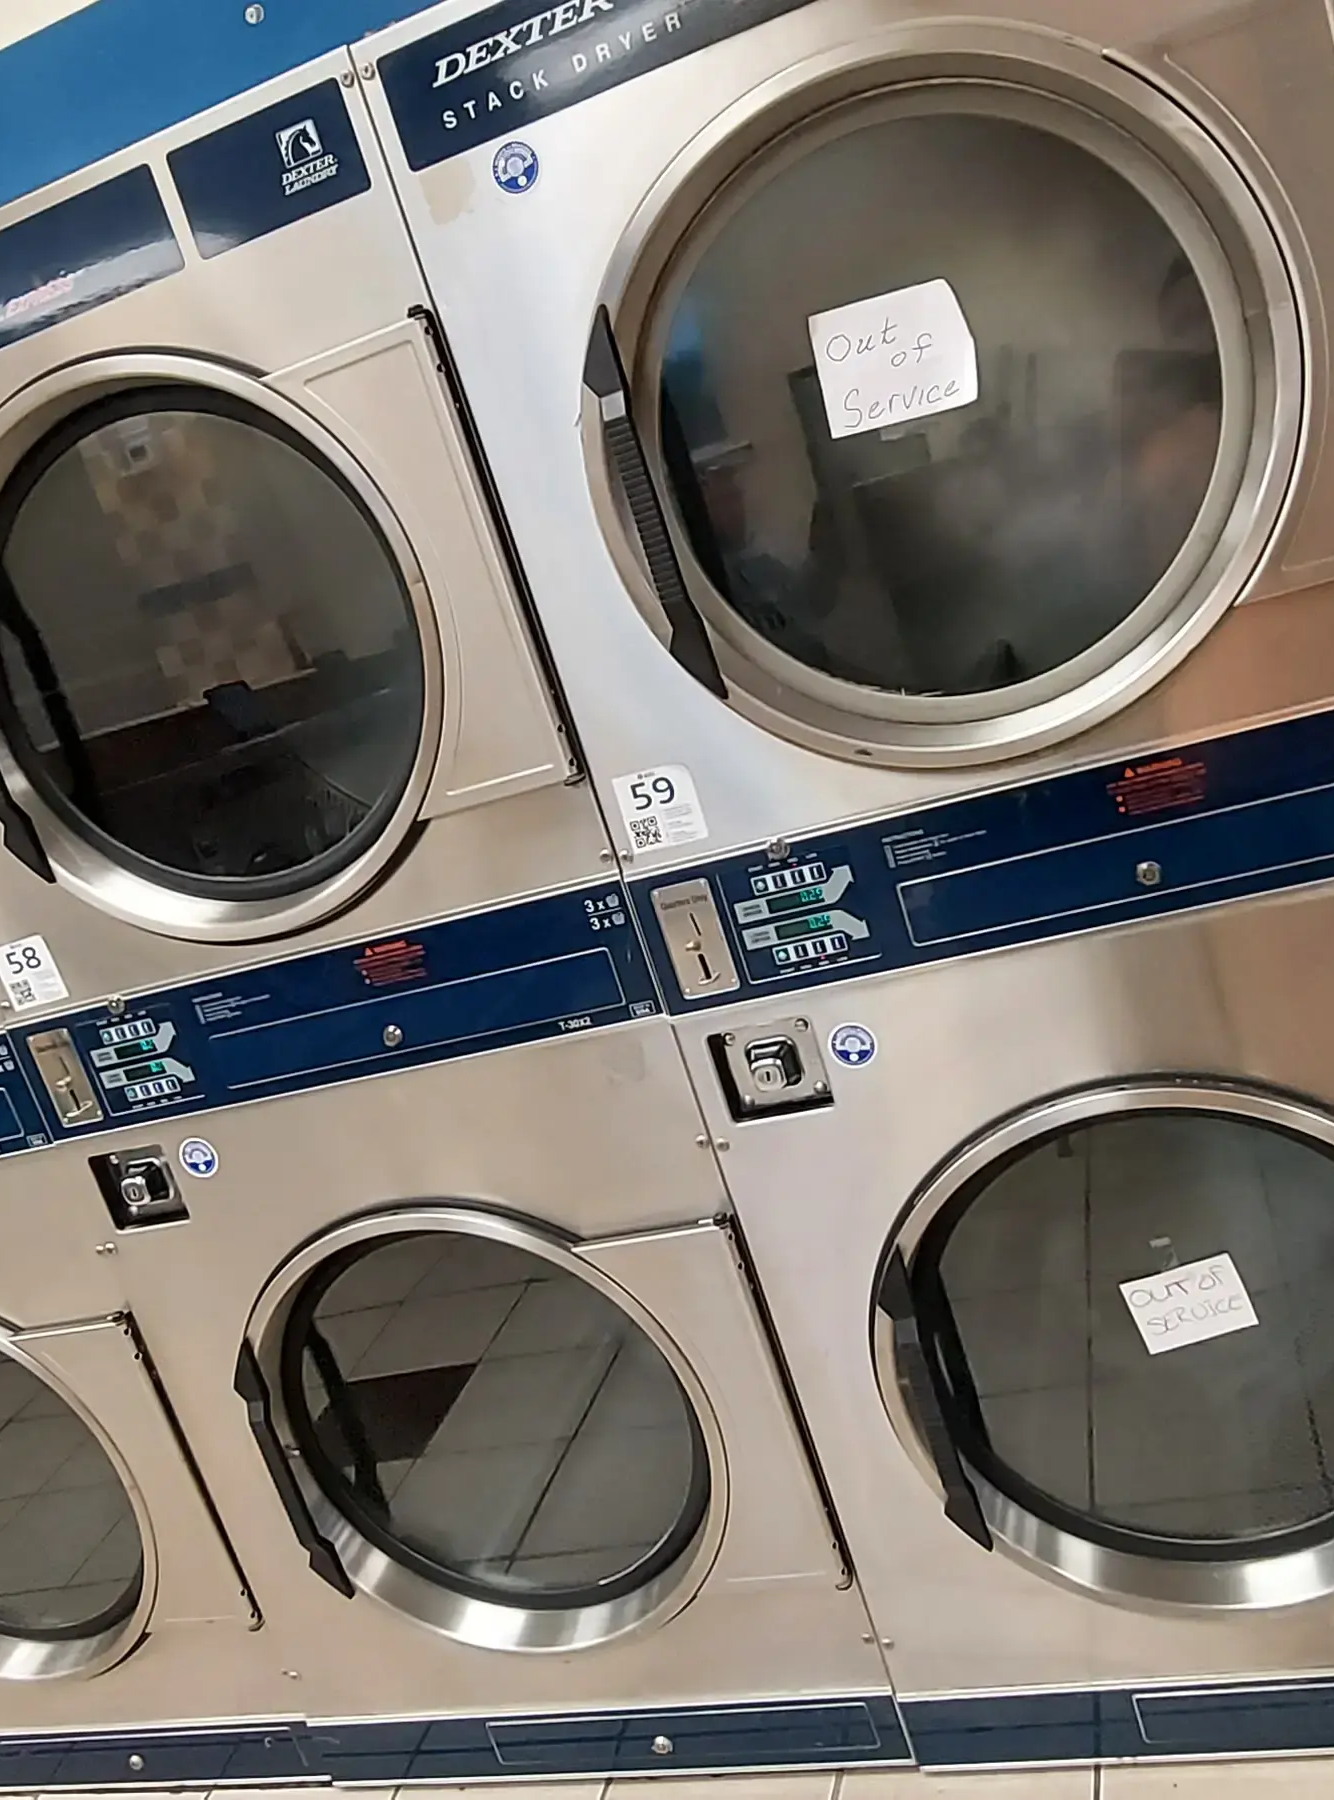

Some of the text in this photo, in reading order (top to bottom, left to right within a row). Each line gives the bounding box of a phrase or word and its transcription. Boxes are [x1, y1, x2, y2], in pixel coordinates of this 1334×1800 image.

[432, 0, 614, 88] DEXTER
[442, 12, 682, 130] STACK DRYER
[281, 154, 336, 186] DEXTER
[826, 316, 898, 362] Out
[891, 332, 933, 368] of
[843, 379, 961, 429] Service
[630, 776, 675, 811] 59
[583, 899, 595, 913] 3
[589, 917, 601, 931] 3
[6, 946, 42, 975] 58
[1128, 1264, 1225, 1309] OUT OF
[1146, 1294, 1245, 1337] SERVICE
